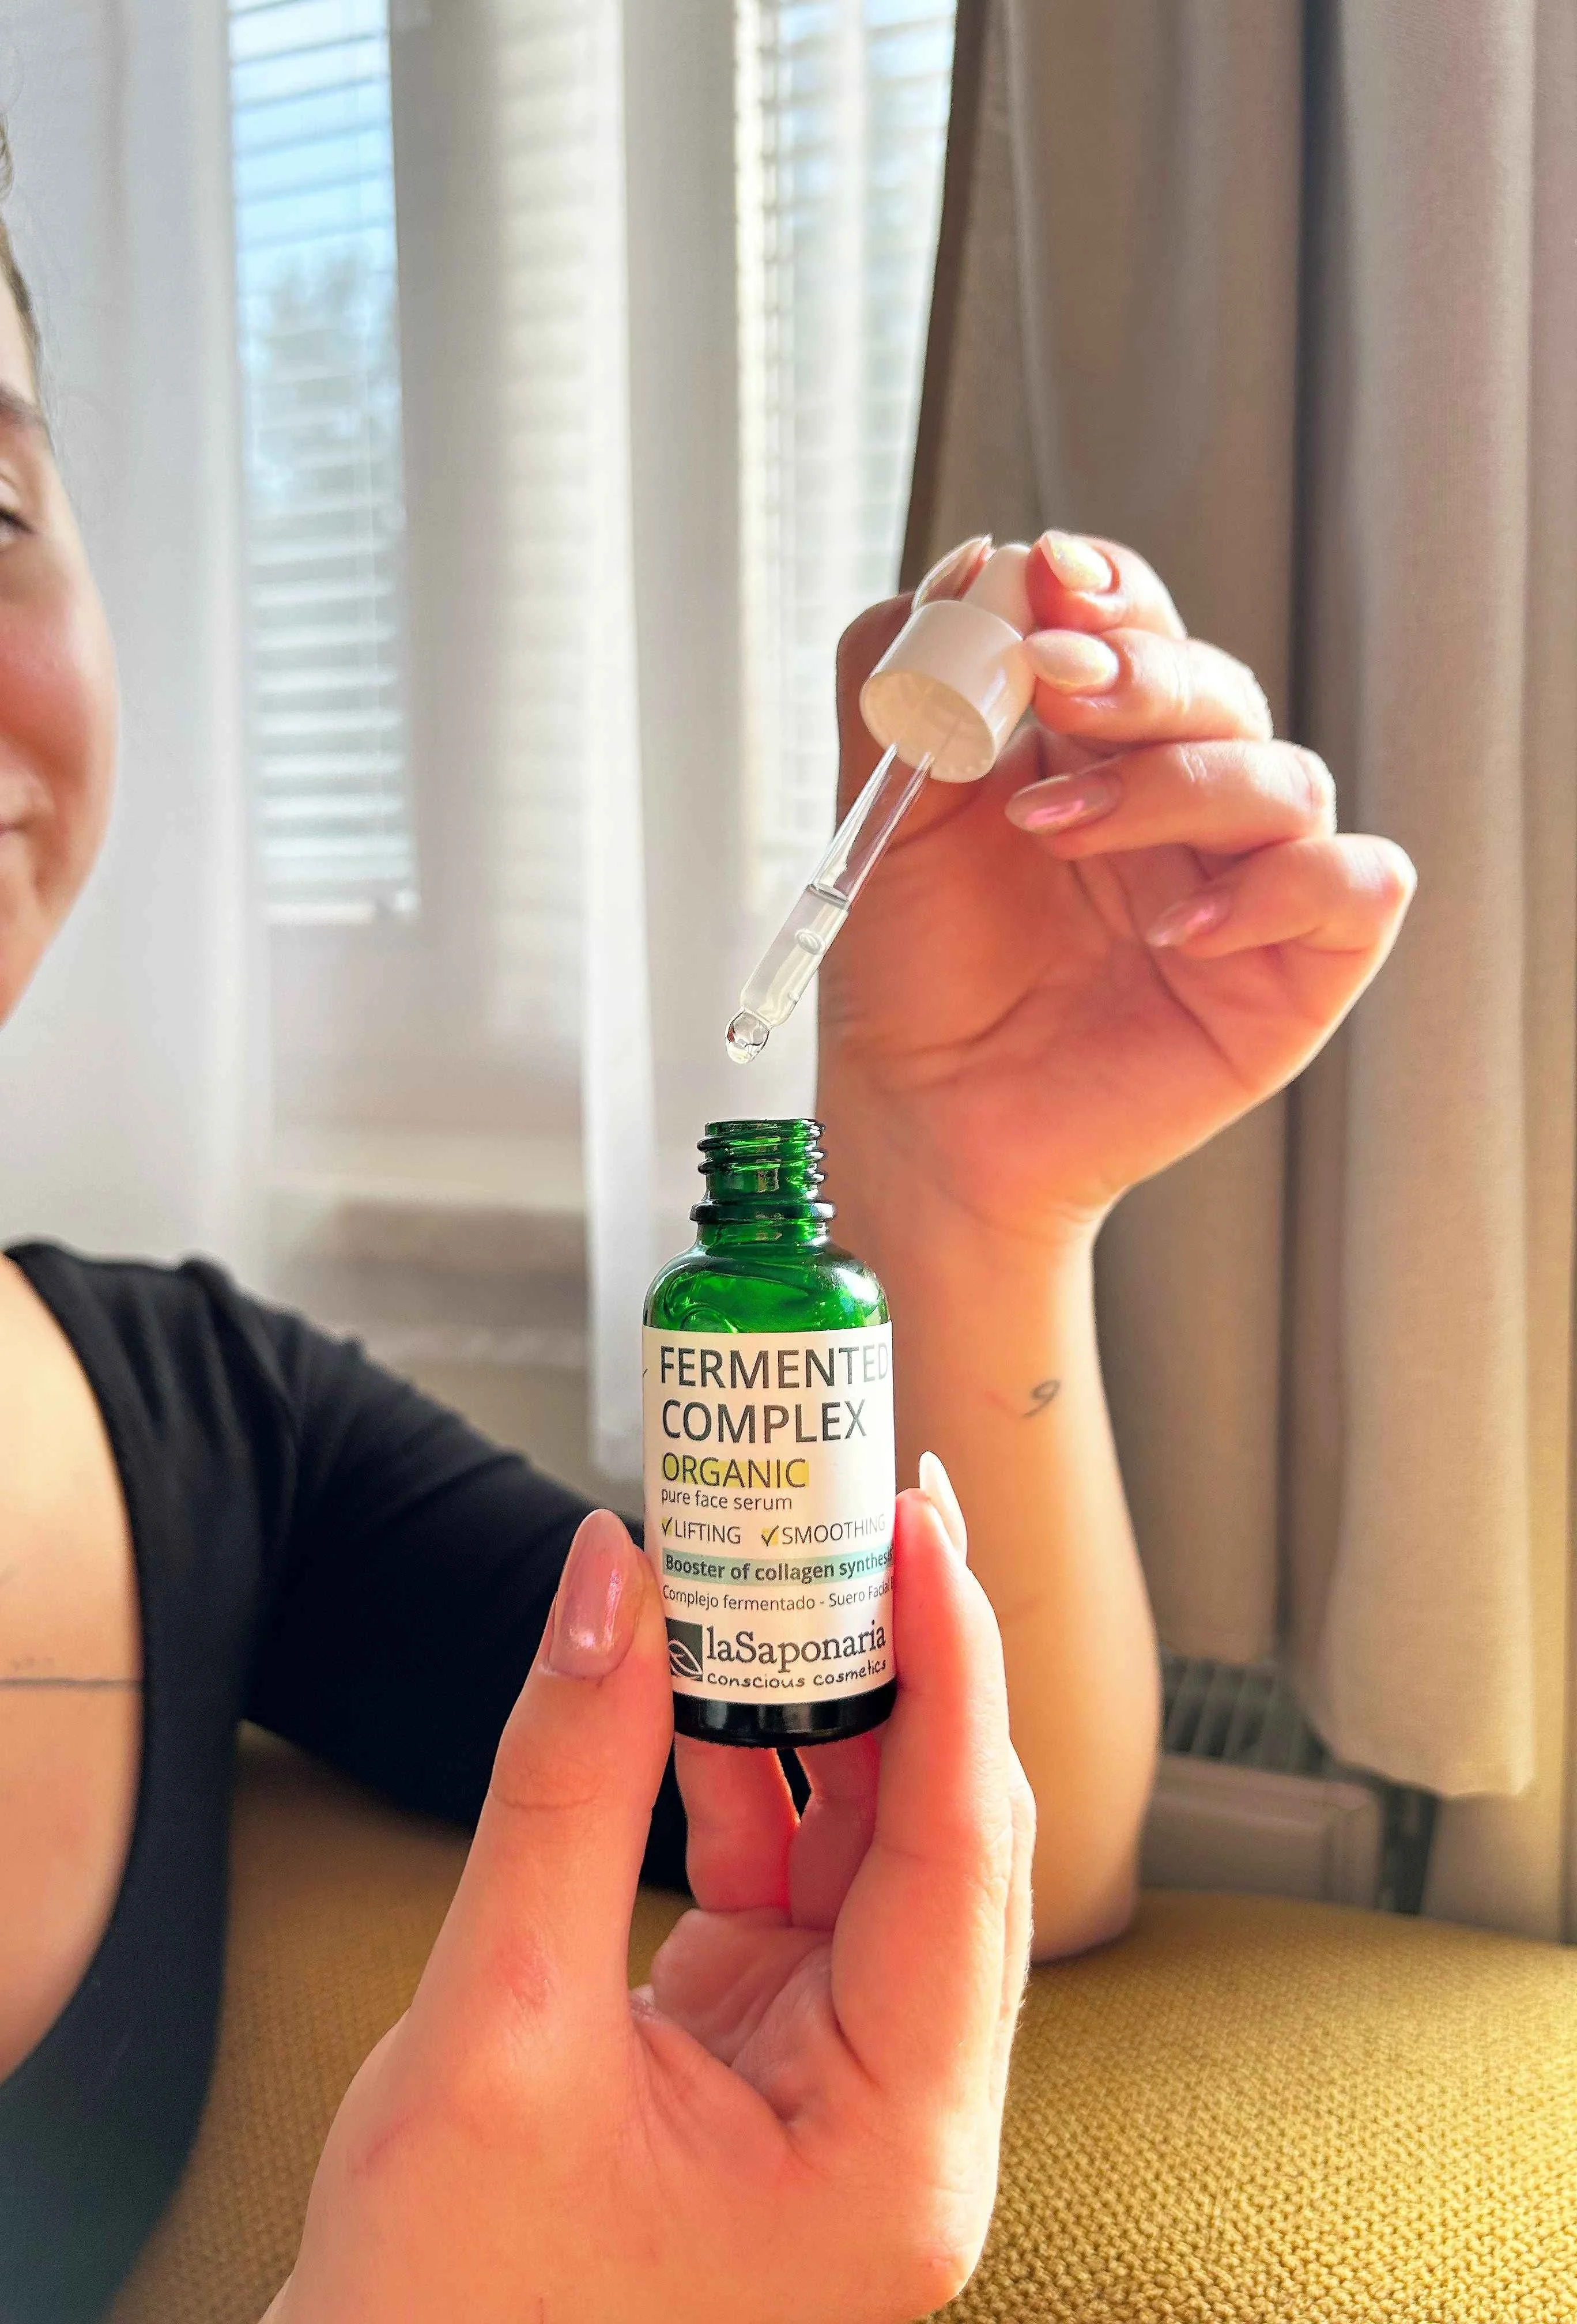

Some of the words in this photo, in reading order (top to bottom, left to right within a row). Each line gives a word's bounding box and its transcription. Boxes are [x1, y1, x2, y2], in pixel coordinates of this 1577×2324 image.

[661, 1342, 888, 1389] FERMENTED
[663, 1398, 867, 1444] COMPLEX
[663, 1452, 806, 1488] ORGANIC
[661, 1488, 691, 1505] pure
[695, 1490, 728, 1508] face
[734, 1496, 793, 1510] serum
[675, 1519, 741, 1544] LIFTING
[782, 1514, 886, 1545] SMOOTHING
[666, 1553, 725, 1578] Booster
[730, 1562, 751, 1580] of
[754, 1561, 835, 1584] collagen
[663, 1584, 719, 1610] Complejo
[723, 1594, 816, 1611] fermentado
[829, 1591, 865, 1607] Suero
[706, 1619, 886, 1673] laSaponaria
[707, 1673, 805, 1688] conscious
[813, 1659, 886, 1687] cosmetics
